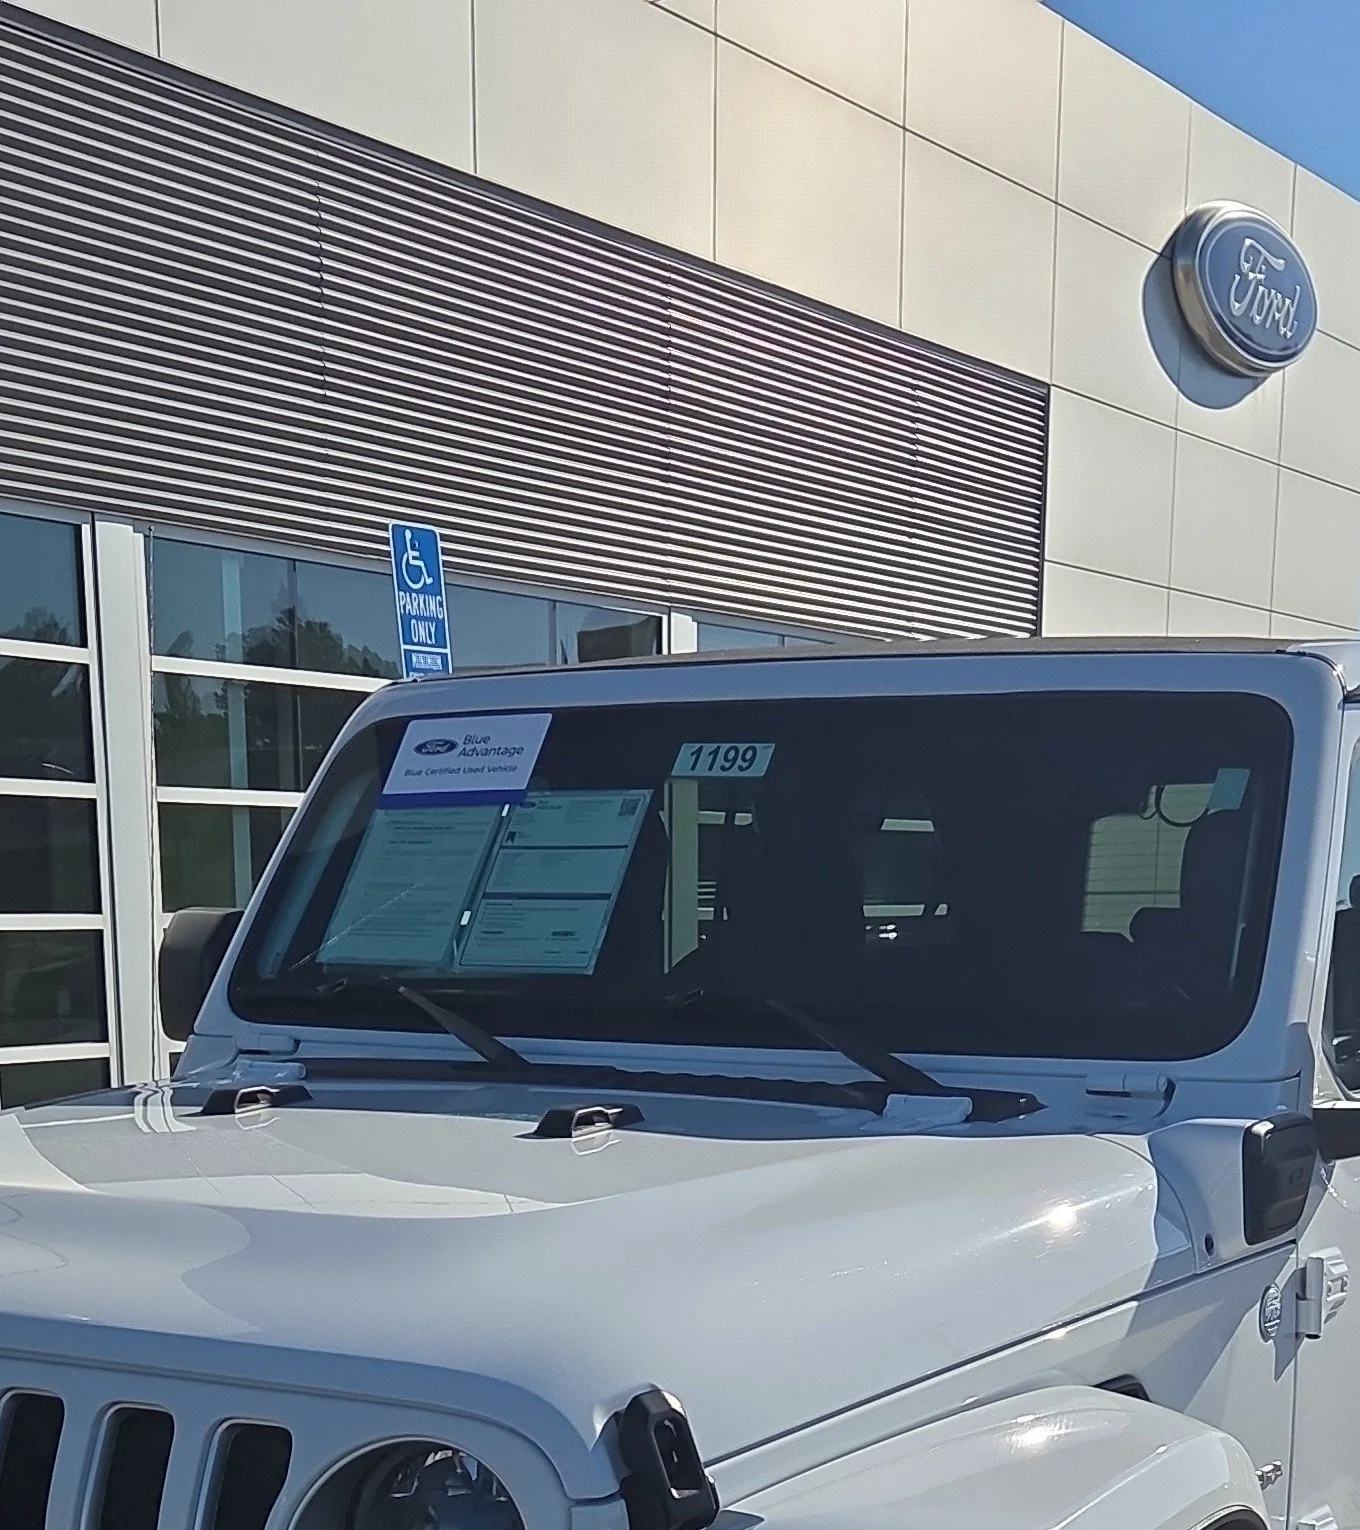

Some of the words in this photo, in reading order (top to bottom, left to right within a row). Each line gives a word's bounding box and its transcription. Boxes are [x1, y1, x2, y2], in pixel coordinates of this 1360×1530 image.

[1229, 237, 1301, 339] Ford
[398, 590, 443, 619] PARKING
[410, 618, 436, 645] ONLY
[457, 745, 525, 758] Advantage
[463, 734, 491, 745] Blue
[403, 768, 423, 777] Blue
[424, 766, 461, 776] Certified
[462, 765, 485, 774] Used
[487, 764, 518, 773] Vehicle
[690, 745, 758, 772] 1199
